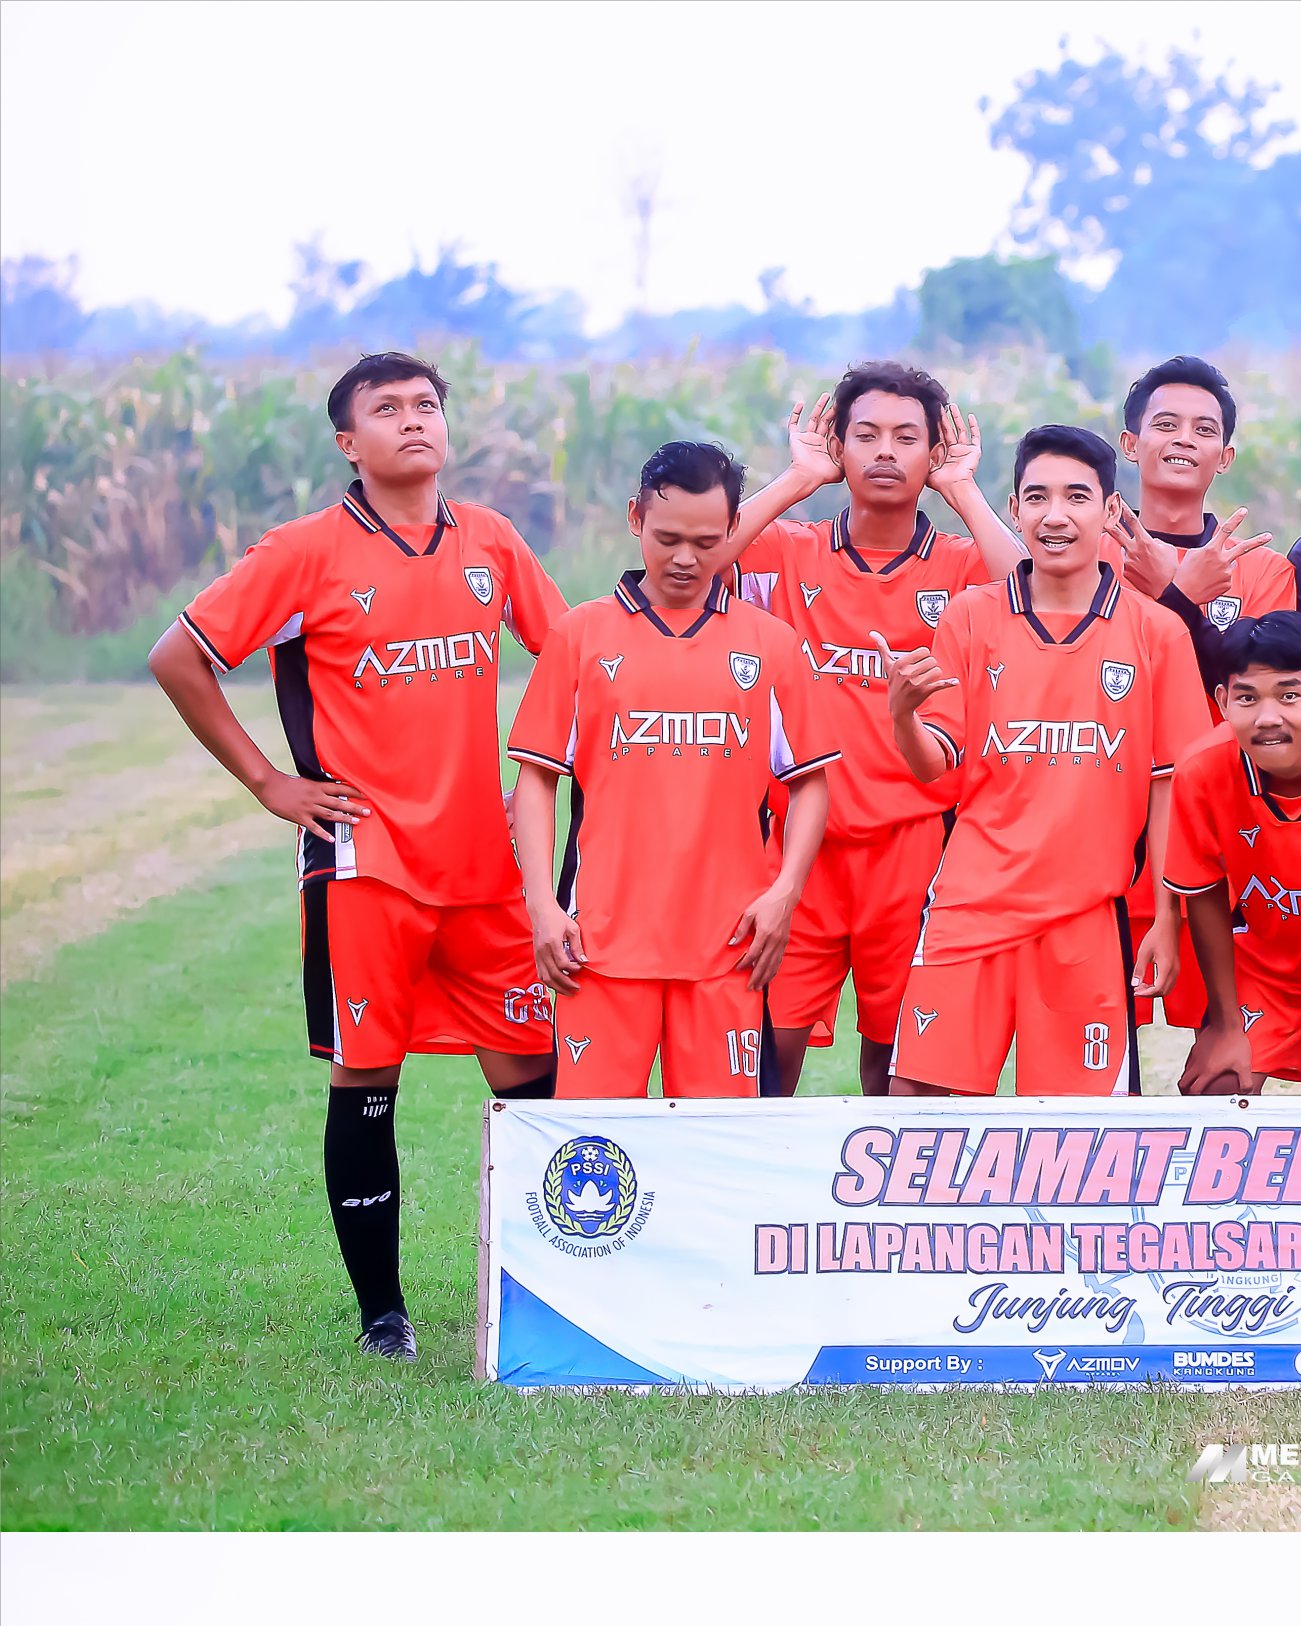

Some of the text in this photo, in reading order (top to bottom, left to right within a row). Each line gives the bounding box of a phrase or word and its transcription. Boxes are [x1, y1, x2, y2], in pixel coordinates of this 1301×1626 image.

[353, 631, 496, 679] AZMOV
[801, 638, 913, 679] AZM
[355, 667, 484, 689] APPARE
[610, 710, 751, 750] AZMOV
[981, 719, 1127, 761] AZMOV
[612, 747, 732, 761] APPARE
[1001, 755, 1124, 773] PPAREL
[1083, 1021, 1109, 1071] 8
[570, 1161, 611, 1176] PSSI
[832, 1126, 1191, 1207] SELAMAT
[525, 1191, 656, 1259] FOOTBALL ASSOCIATION OF INDONESIA
[754, 1224, 808, 1275] DI
[815, 1222, 1065, 1274] LAPANGAN
[1207, 1273, 1279, 1285] NGKUNG
[952, 1282, 1137, 1334] Junjung
[1162, 1279, 1296, 1331] Tinggi
[865, 1356, 941, 1375] Support
[946, 1356, 971, 1374] By
[1066, 1357, 1140, 1372] AZMOV
[1173, 1351, 1256, 1368] BUMDES
[1173, 1367, 1256, 1376] KANGKUNG
